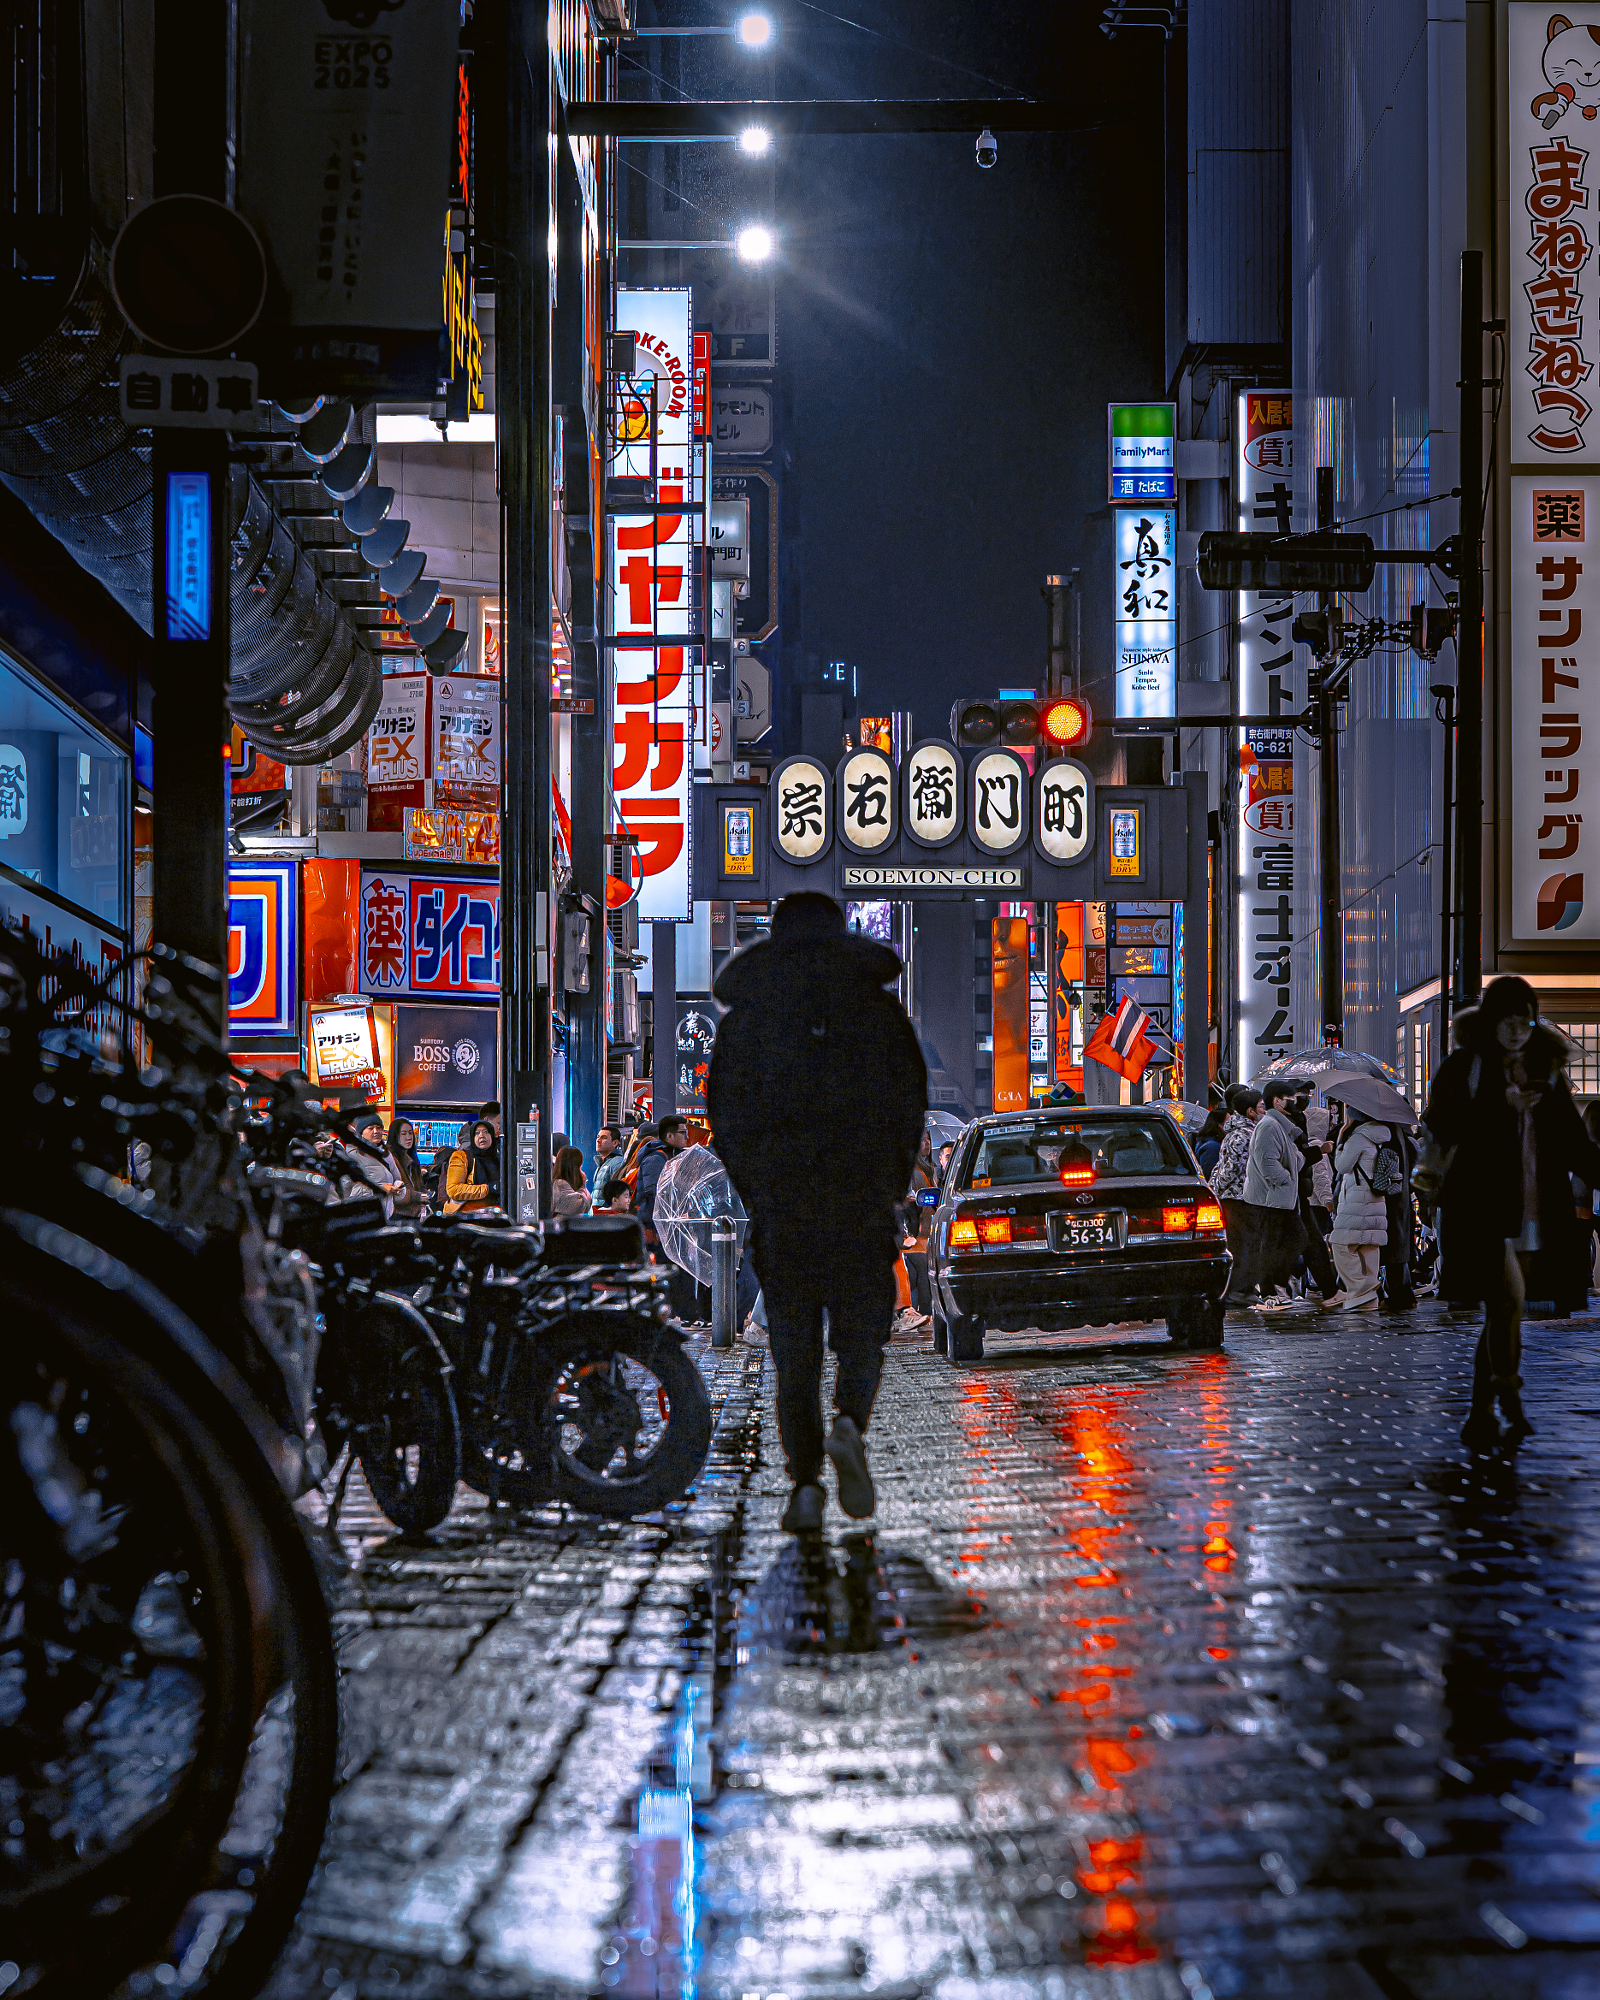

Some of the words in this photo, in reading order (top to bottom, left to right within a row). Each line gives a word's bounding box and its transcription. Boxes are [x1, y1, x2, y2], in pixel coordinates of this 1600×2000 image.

[314, 41, 393, 65] EXPO
[314, 66, 391, 89] 2025
[1526, 137, 1593, 453] まねきねこ
[716, 423, 740, 440] ビル
[1115, 446, 1171, 458] FamilyMart
[1255, 437, 1293, 467] 賃
[1120, 479, 1134, 494] 酒
[1138, 480, 1165, 493] たばこ
[1537, 493, 1582, 539] 薬
[1119, 517, 1172, 618] 真和
[737, 582, 746, 592] 7
[737, 641, 746, 652] 6
[1121, 653, 1170, 664] SHINWA
[613, 466, 684, 877] ジャンカラ
[737, 702, 746, 713] 5
[1535, 555, 1583, 860] サンドラッグ
[372, 716, 416, 736] アリナミン
[440, 715, 493, 736] アリナミン
[371, 735, 415, 765] EX
[379, 757, 419, 781] PLUS
[450, 759, 497, 783] PLUS
[737, 764, 746, 775] 4
[1257, 800, 1293, 831] 賃
[729, 827, 749, 835] Asahi
[1115, 828, 1134, 838] Asahi
[407, 848, 431, 858] Super
[434, 848, 451, 859] Sale
[848, 869, 1017, 885] SOEMON-CHO
[365, 885, 405, 984] 薬
[414, 887, 500, 984] ダイコ
[317, 1032, 360, 1047] アリナミン
[413, 1045, 450, 1063] BOSS
[329, 1056, 368, 1074] PLUS
[418, 1063, 446, 1072] COFFEE
[357, 1072, 379, 1083] NOW
[1070, 1226, 1114, 1245] 56-34
